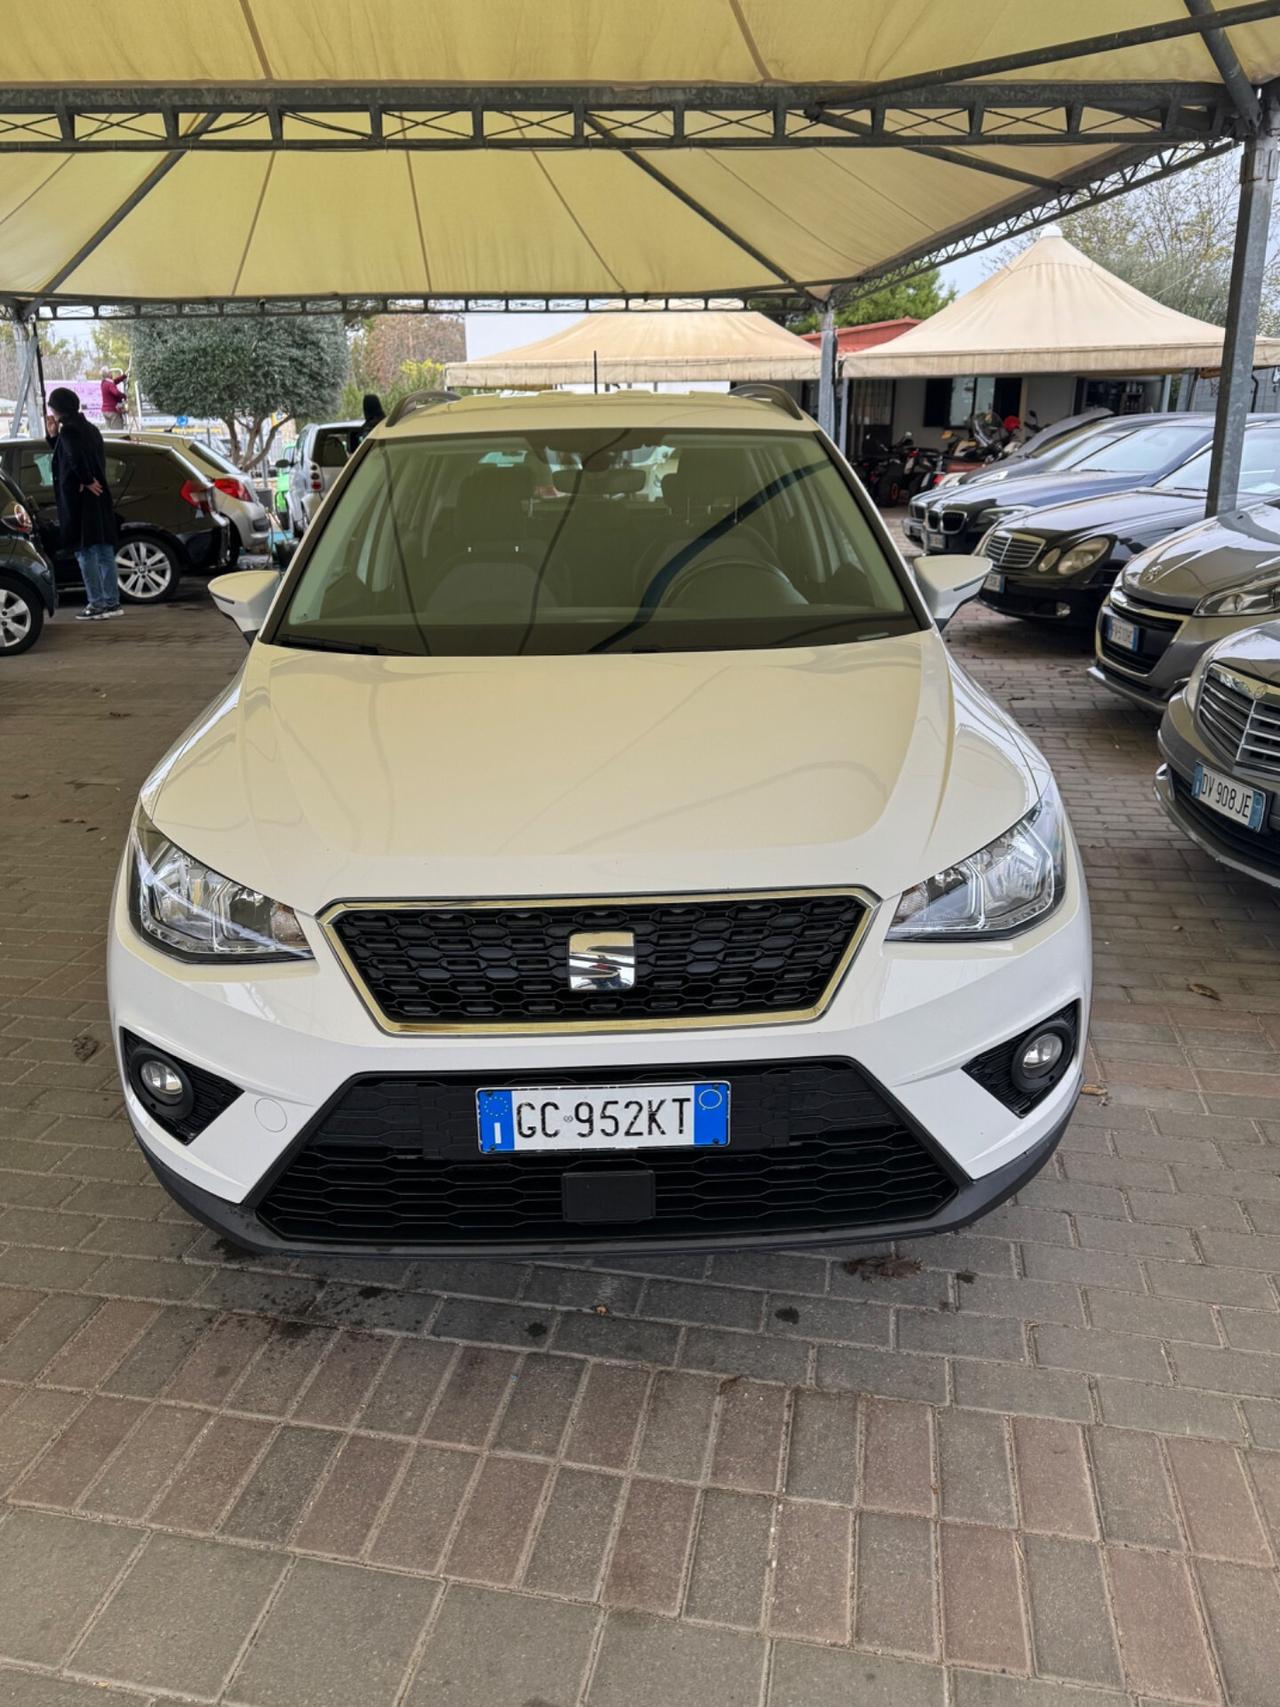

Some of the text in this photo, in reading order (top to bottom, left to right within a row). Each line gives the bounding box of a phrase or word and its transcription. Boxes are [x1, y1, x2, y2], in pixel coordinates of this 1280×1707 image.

[1201, 773, 1252, 818] DV 908JE
[516, 1097, 691, 1138] GC 952KT
